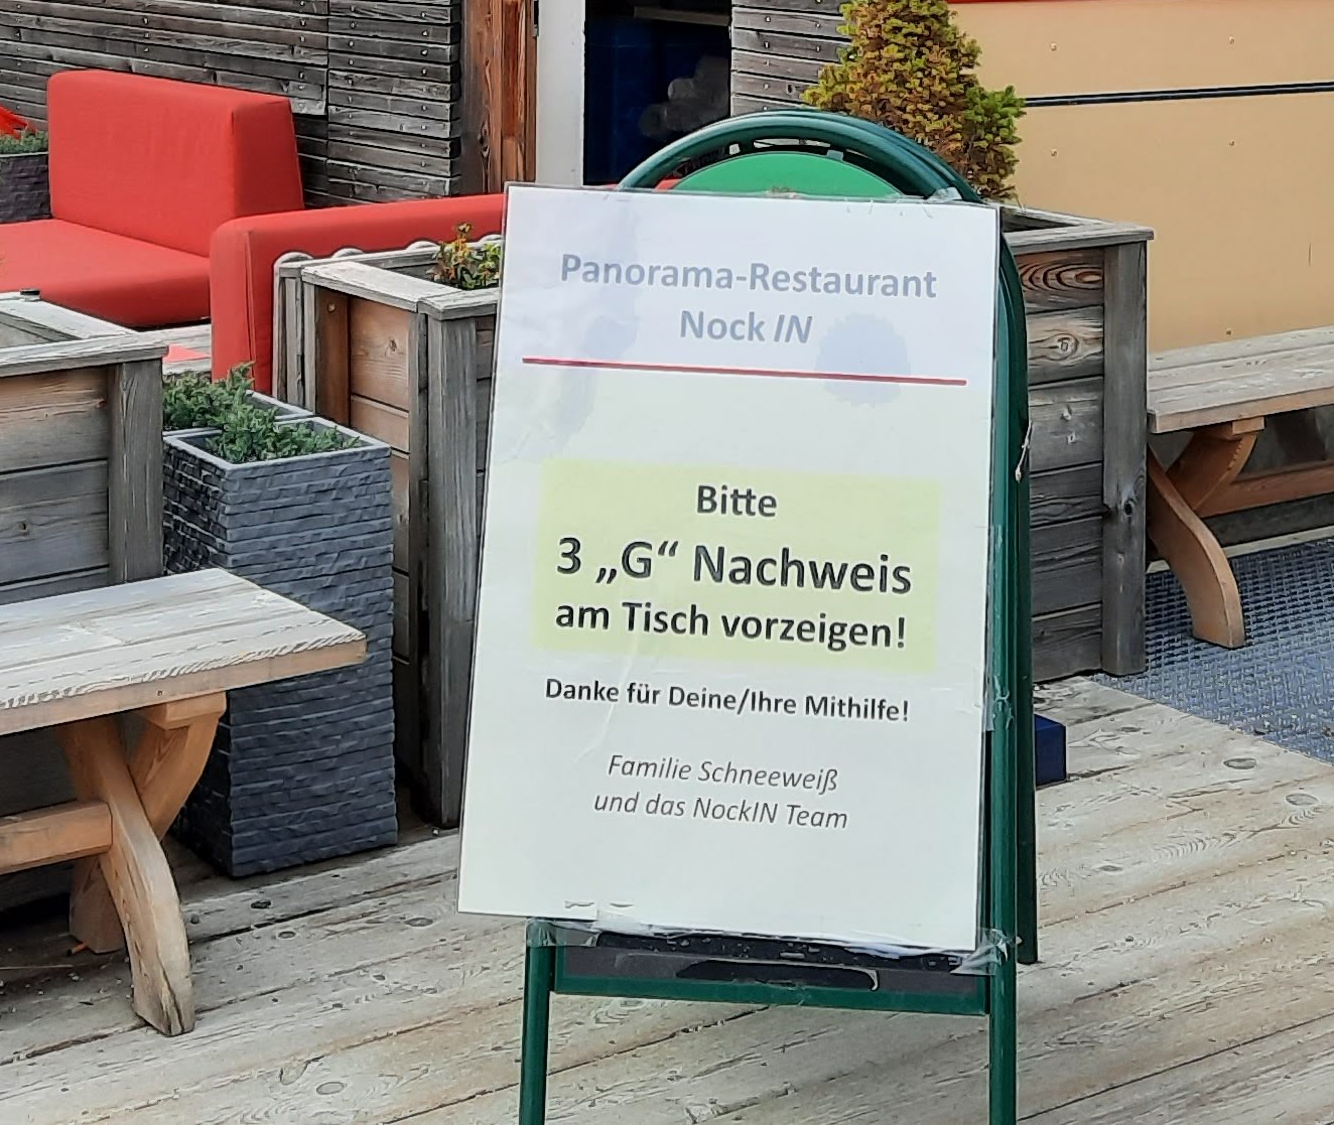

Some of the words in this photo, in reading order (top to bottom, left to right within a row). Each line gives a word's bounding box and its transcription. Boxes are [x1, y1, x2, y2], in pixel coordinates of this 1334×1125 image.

[560, 253, 937, 299] Panorama-Restaurant
[679, 310, 765, 342] Nock
[773, 315, 813, 345] IN
[696, 484, 778, 518] Bitte
[556, 538, 583, 575] 3
[694, 545, 912, 594] Nachweis
[555, 602, 610, 629] am
[622, 601, 709, 636] Tisch
[721, 613, 906, 651] vorzeigen!
[545, 678, 619, 704] Danke
[627, 682, 661, 706] für
[668, 685, 797, 716] Deine/Ihre
[805, 694, 910, 722] Mithilfe!
[607, 754, 692, 781] Familie
[698, 760, 839, 793] Schneeweiß
[593, 791, 637, 814] und
[645, 796, 685, 818] das
[693, 797, 778, 824] NockIN
[786, 803, 849, 830] Team
